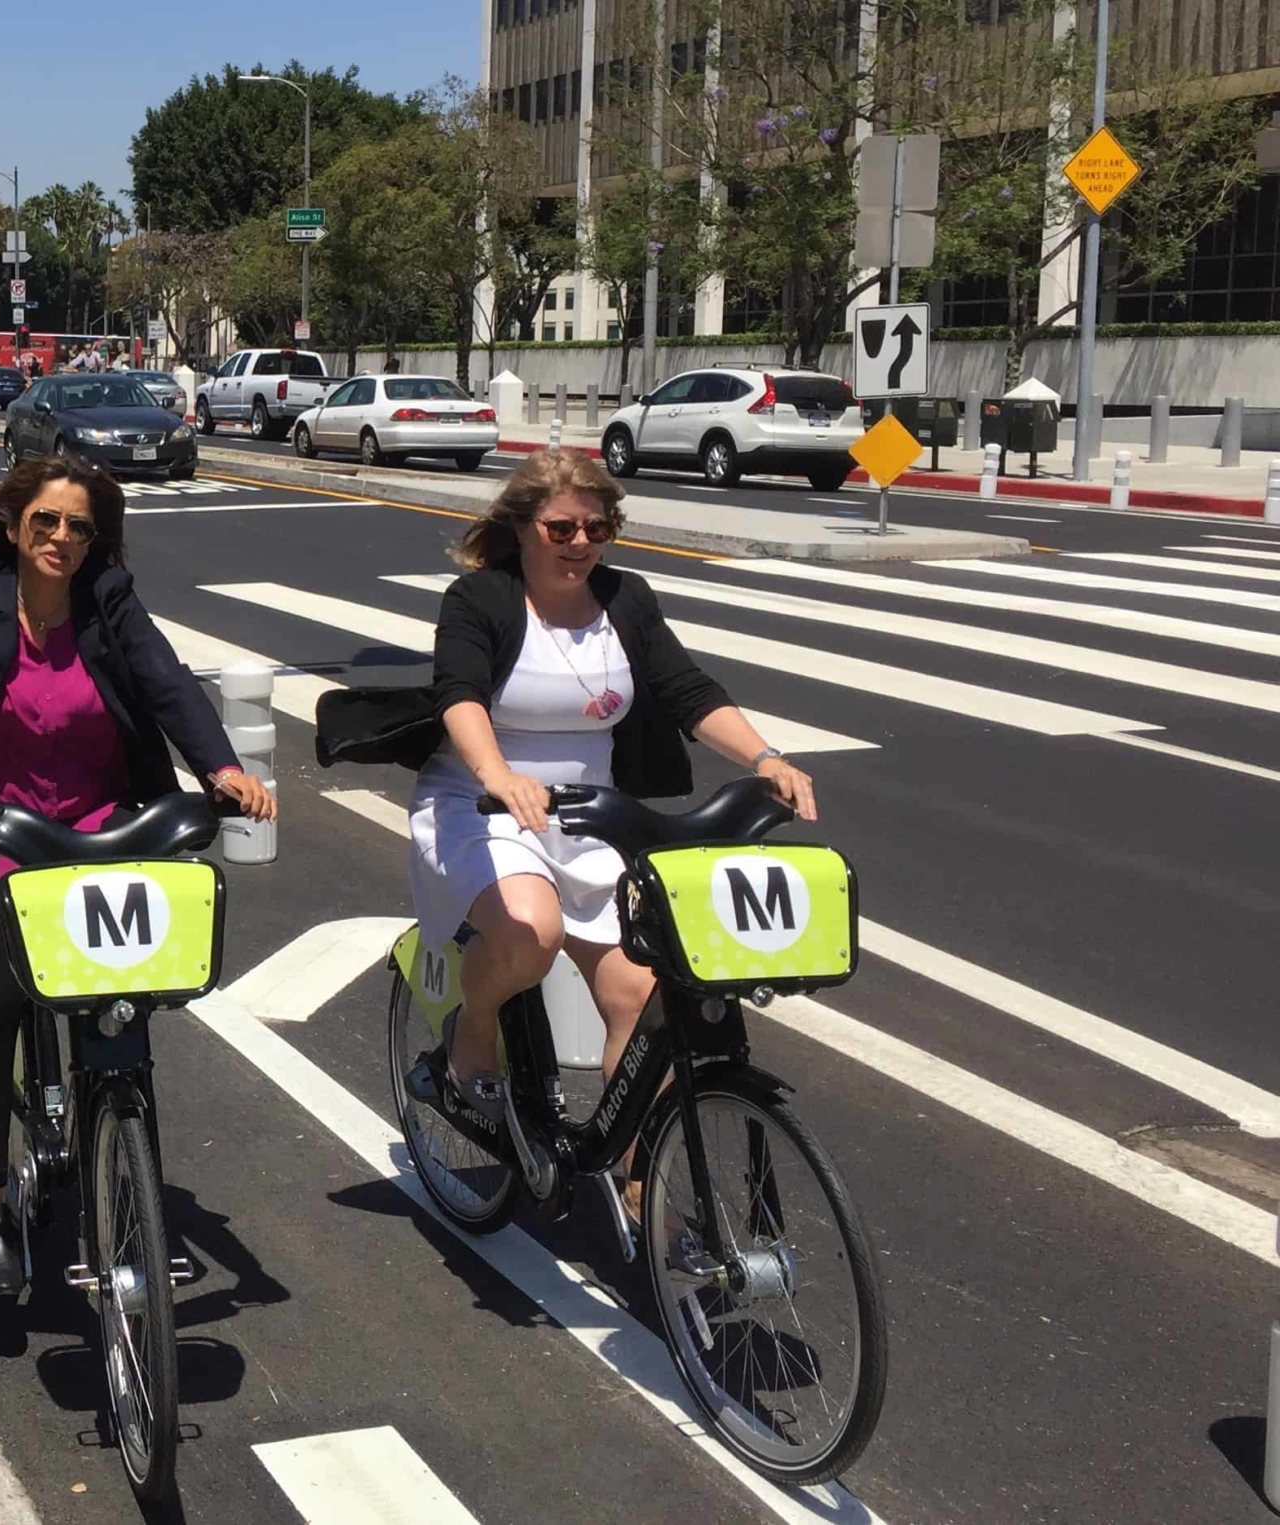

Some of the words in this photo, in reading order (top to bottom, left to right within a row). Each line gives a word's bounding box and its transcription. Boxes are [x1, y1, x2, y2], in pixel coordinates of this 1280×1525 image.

[1079, 159, 1101, 167] RIGHT
[1104, 159, 1124, 167] LANE
[82, 882, 152, 948] M
[724, 866, 796, 931] M
[425, 951, 445, 995] M
[596, 1078, 629, 1138] Metro
[623, 1033, 650, 1080] Bike
